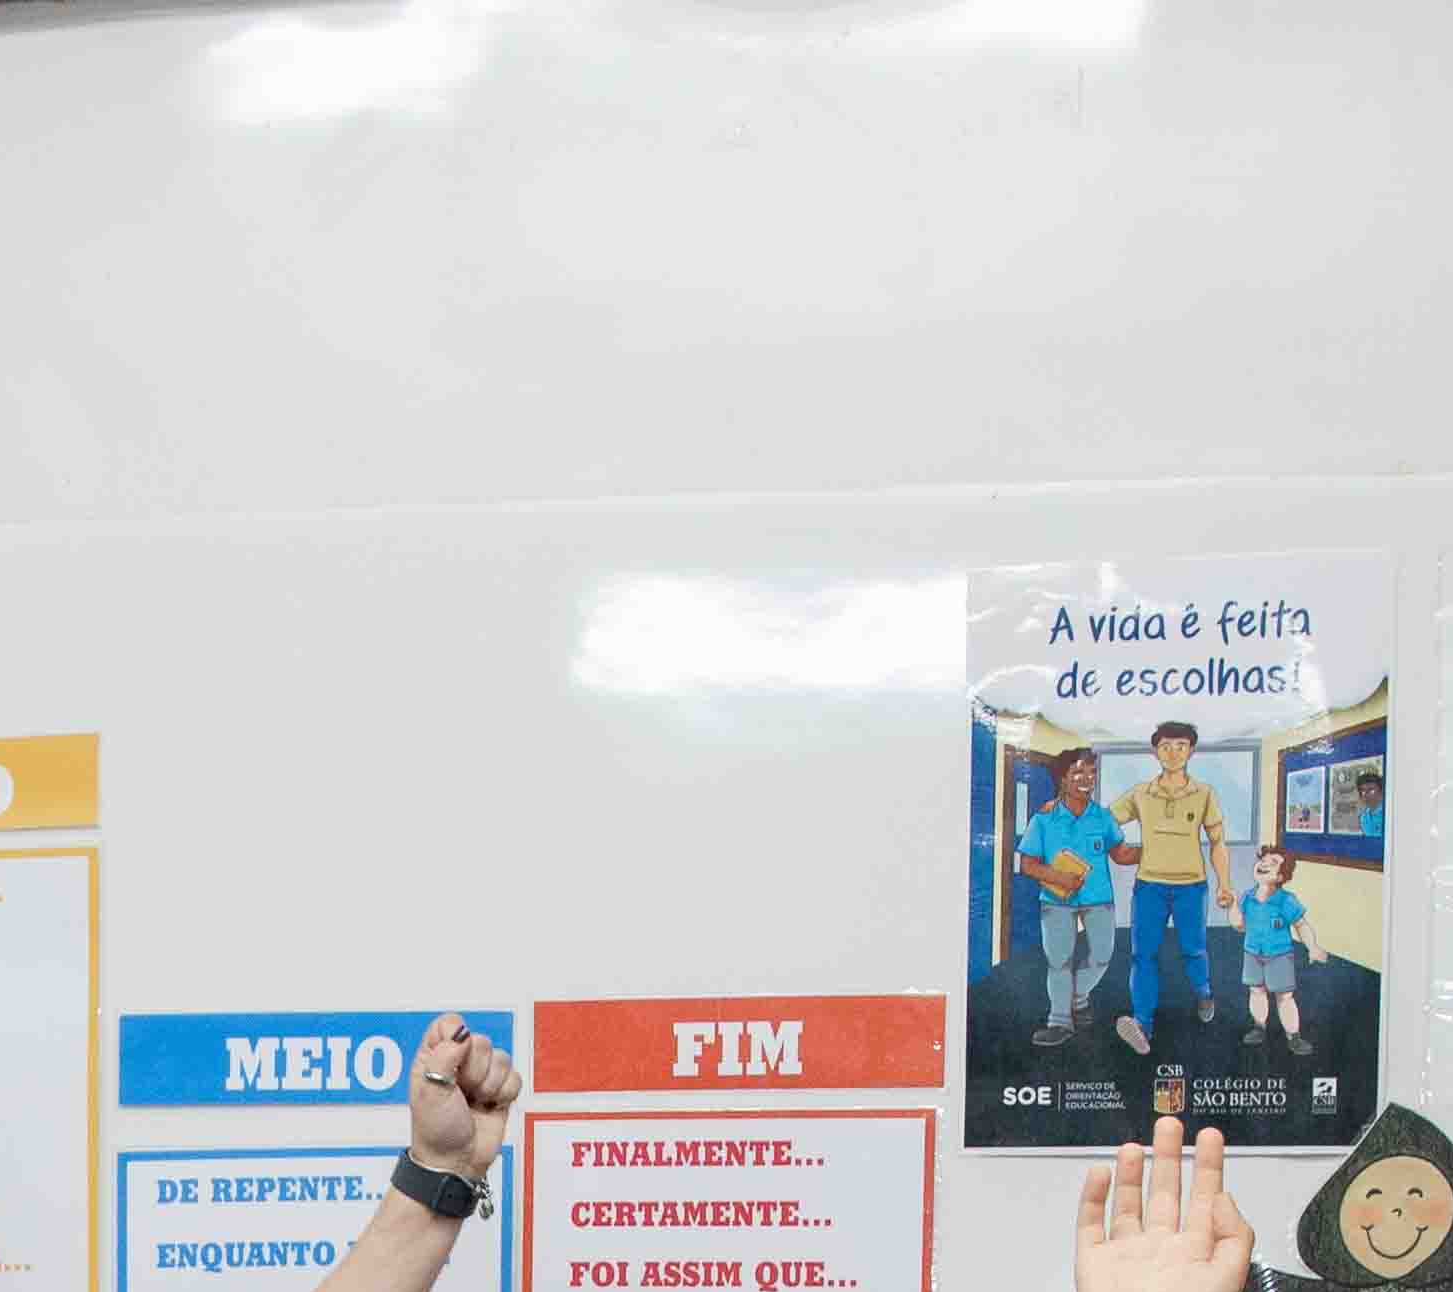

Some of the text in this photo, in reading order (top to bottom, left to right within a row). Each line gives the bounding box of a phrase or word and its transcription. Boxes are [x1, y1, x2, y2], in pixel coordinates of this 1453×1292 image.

[1048, 600, 1311, 646] A vida é feita
[1057, 657, 1302, 699] de escolhas!
[225, 1036, 403, 1093] MEIO
[672, 1020, 805, 1080] FIM
[1002, 1086, 1053, 1107] SOE
[1193, 1076, 1286, 1091] COLÉGIO DE
[1193, 1088, 1287, 1108] SÃO BENTO
[570, 1140, 826, 1168] FINALMENTE...
[157, 1179, 198, 1203] DE
[570, 1201, 834, 1229] CERTAMENTE...
[157, 1240, 336, 1273] ENQUANTO
[569, 1261, 859, 1292] FOI ASSIM QUE...
